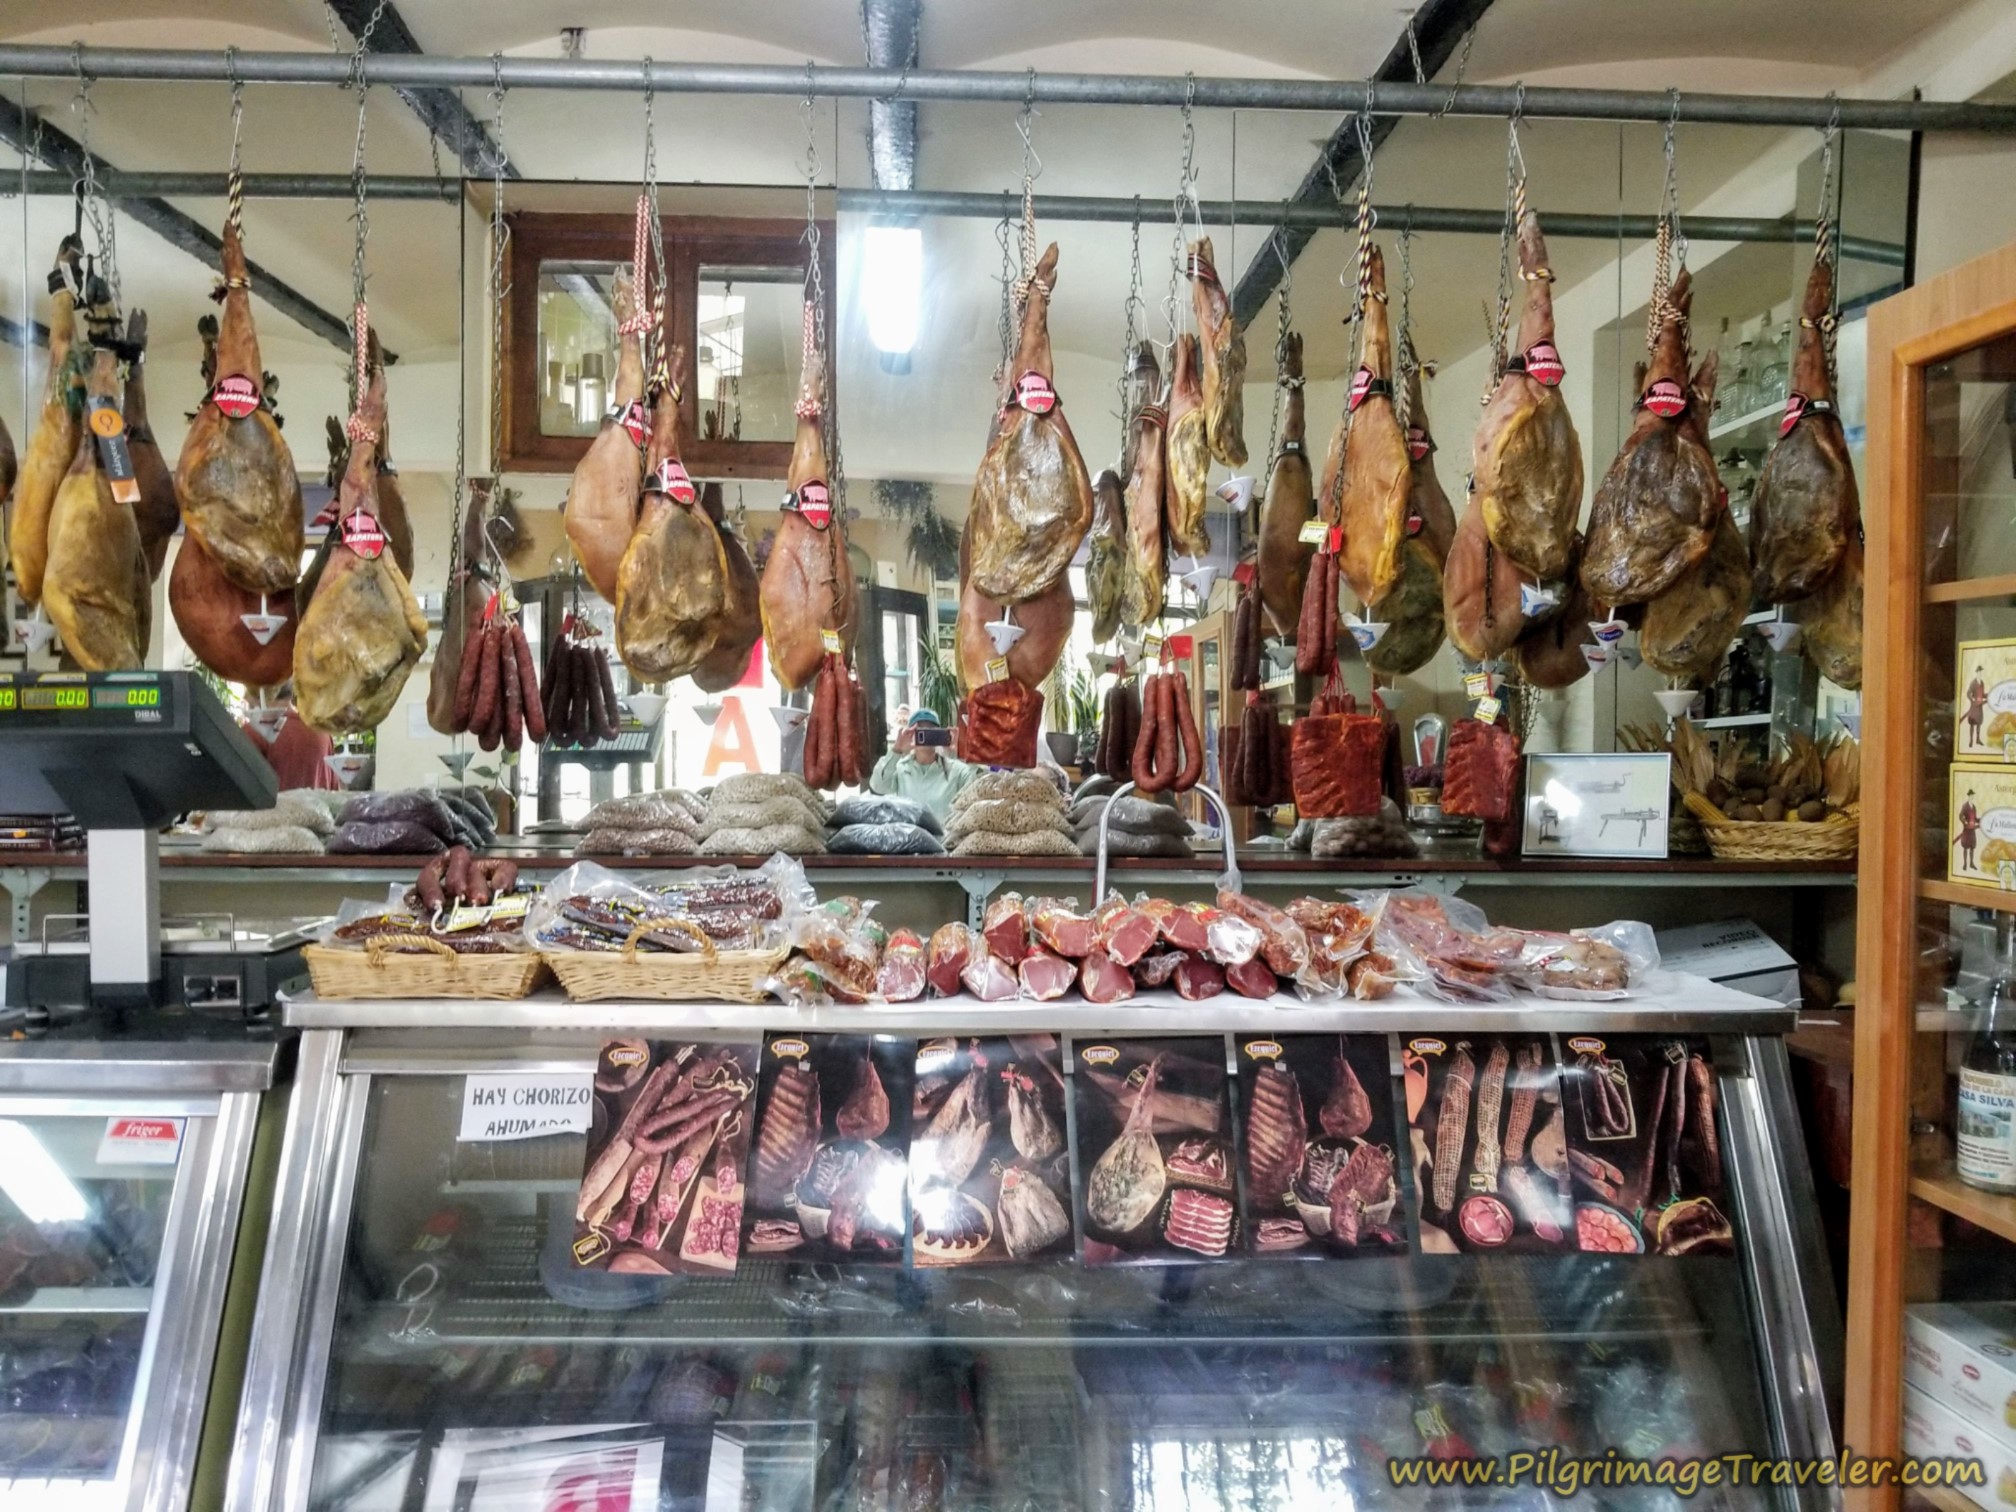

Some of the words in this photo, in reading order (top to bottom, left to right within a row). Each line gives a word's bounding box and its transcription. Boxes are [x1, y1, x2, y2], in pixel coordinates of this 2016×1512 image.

[214, 393, 259, 405] ZAPATERO
[1643, 395, 1686, 405] ZAPATERO
[473, 1087, 507, 1106] HAY
[513, 1087, 591, 1106] CHORIZO
[1979, 1094, 2015, 1109] SILVA
[122, 1121, 163, 1137] friger
